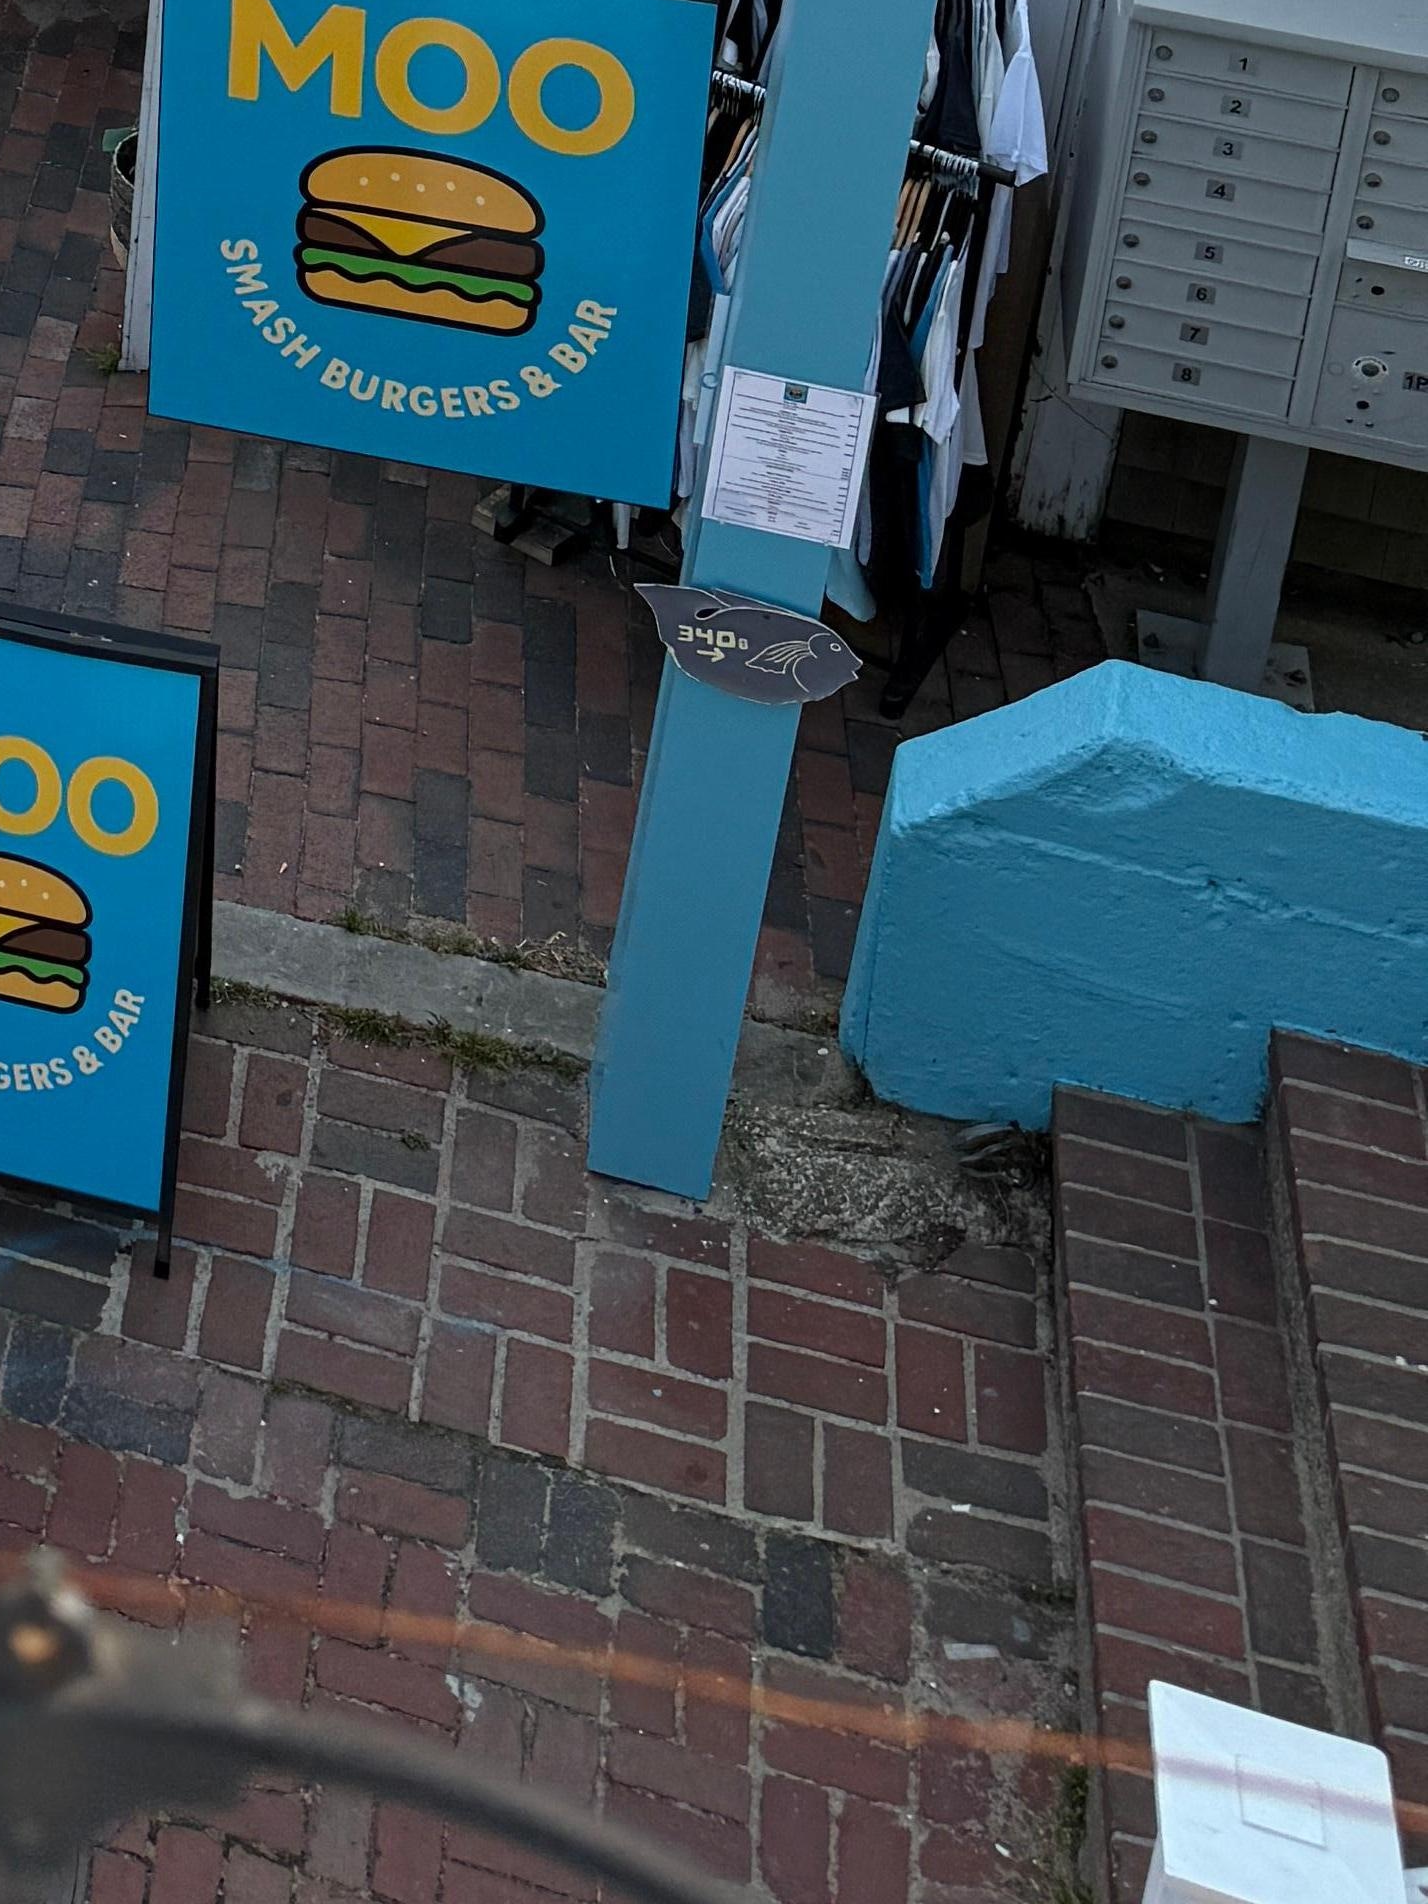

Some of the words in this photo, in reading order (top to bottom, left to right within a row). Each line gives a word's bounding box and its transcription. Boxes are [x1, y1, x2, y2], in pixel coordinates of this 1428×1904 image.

[1239, 56, 1249, 72] 1
[1229, 99, 1243, 114] 2
[1222, 142, 1235, 157] 3
[1212, 184, 1227, 198] 4
[1204, 245, 1217, 261] 5
[1195, 286, 1208, 302] 6
[217, 236, 328, 374] SMASH
[317, 356, 524, 421] BURGERS
[518, 363, 564, 400] &
[547, 297, 620, 379] BAR
[1189, 326, 1202, 342] 7
[1180, 366, 1193, 382] 8
[70, 1046, 105, 1077] &
[95, 986, 147, 1055] BAR
